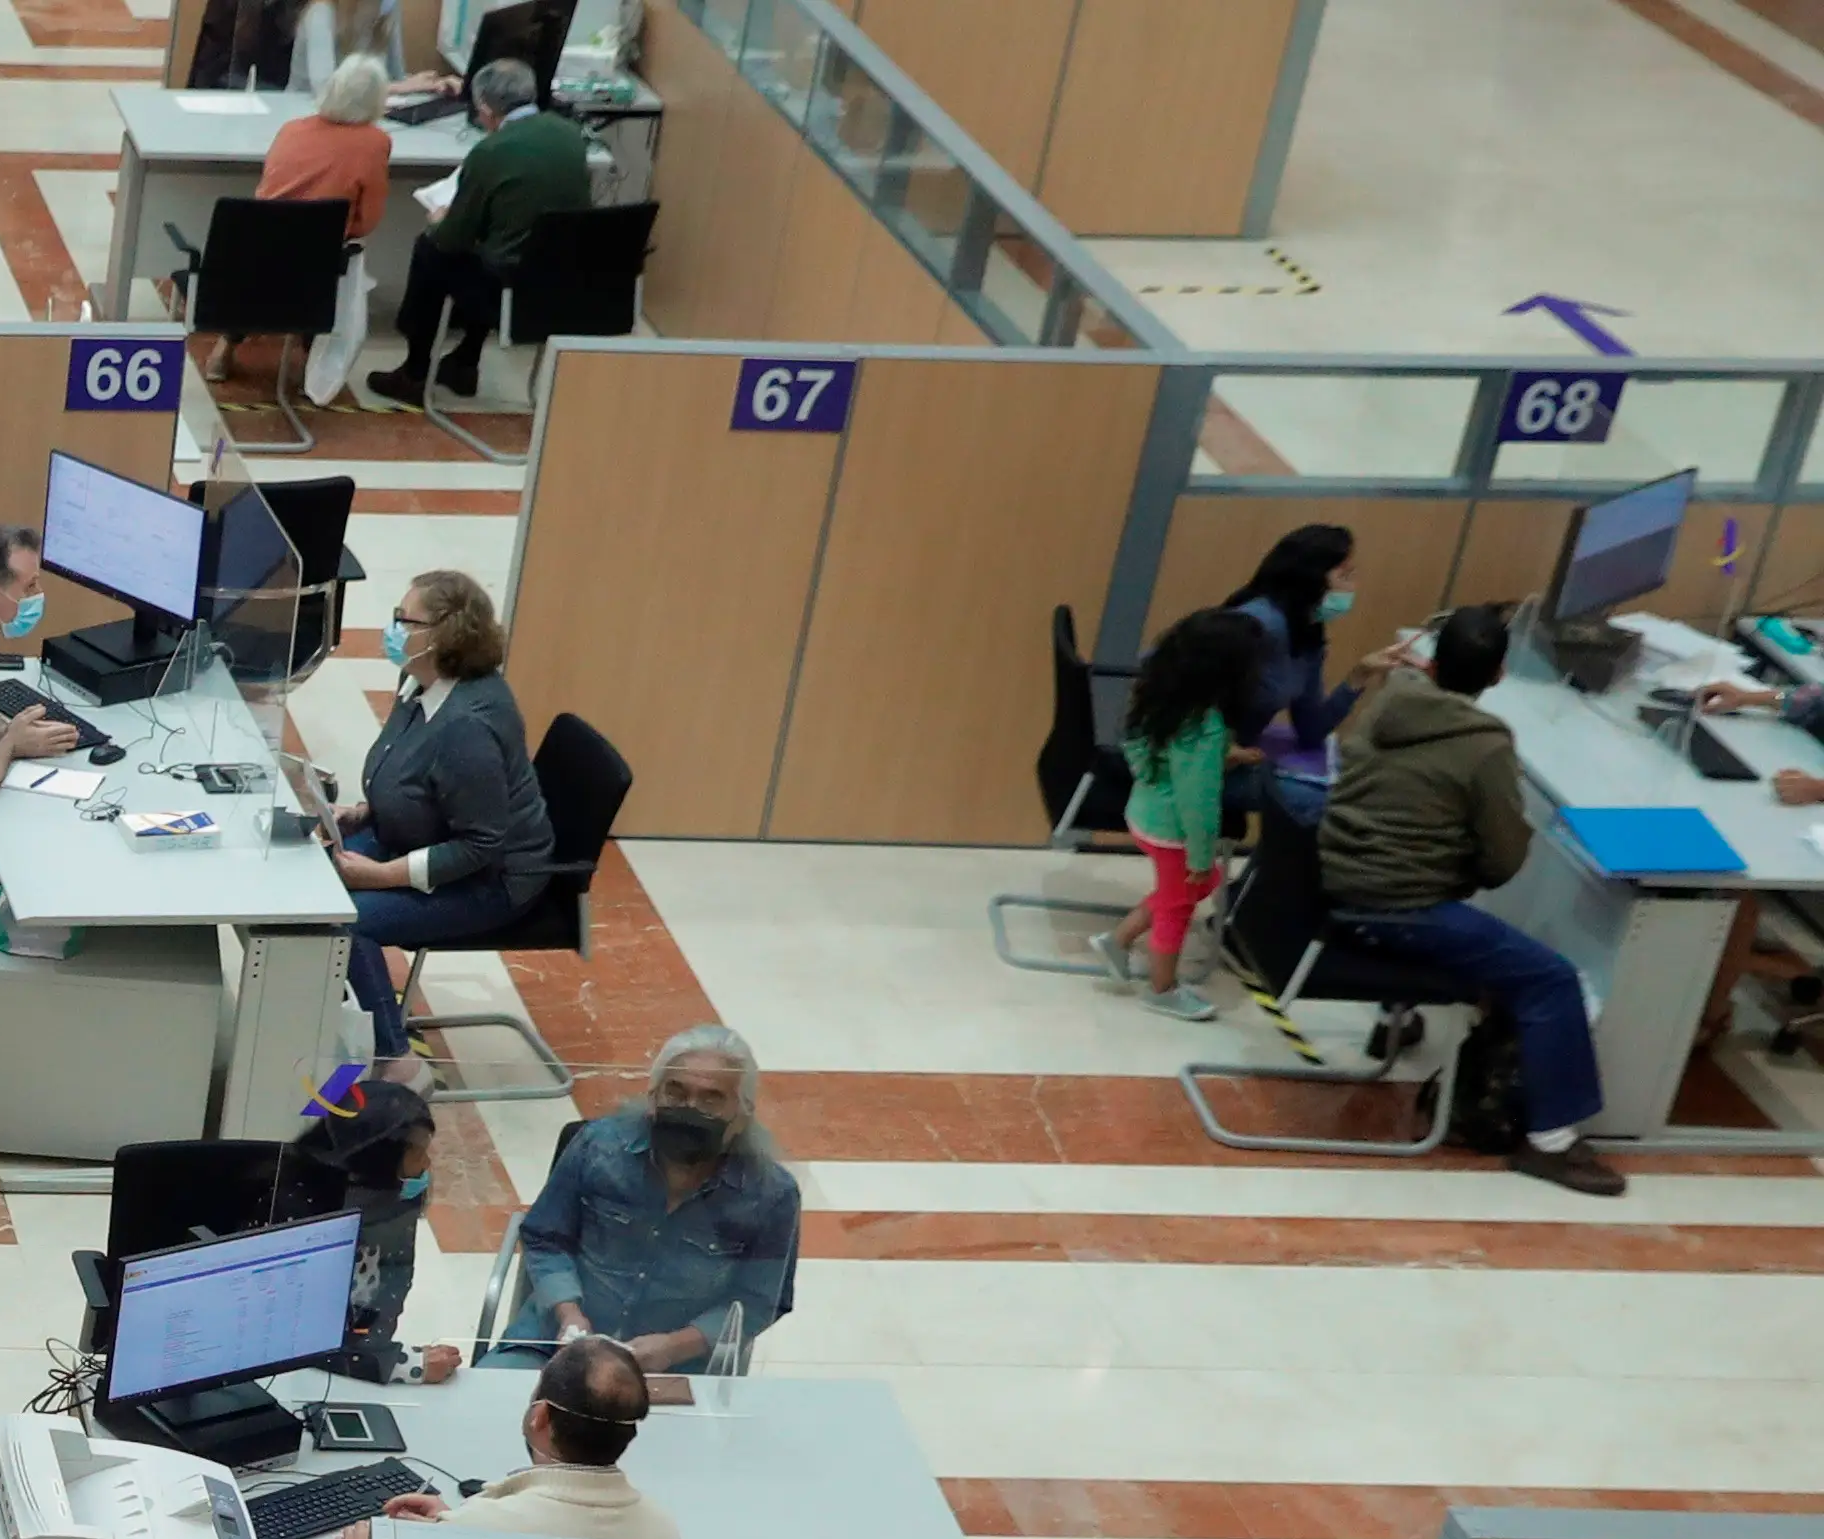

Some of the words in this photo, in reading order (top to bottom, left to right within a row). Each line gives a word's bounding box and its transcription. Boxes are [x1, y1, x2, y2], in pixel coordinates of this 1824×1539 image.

[86, 348, 161, 400] 66
[752, 367, 834, 421] 67
[1516, 379, 1600, 434] 68
